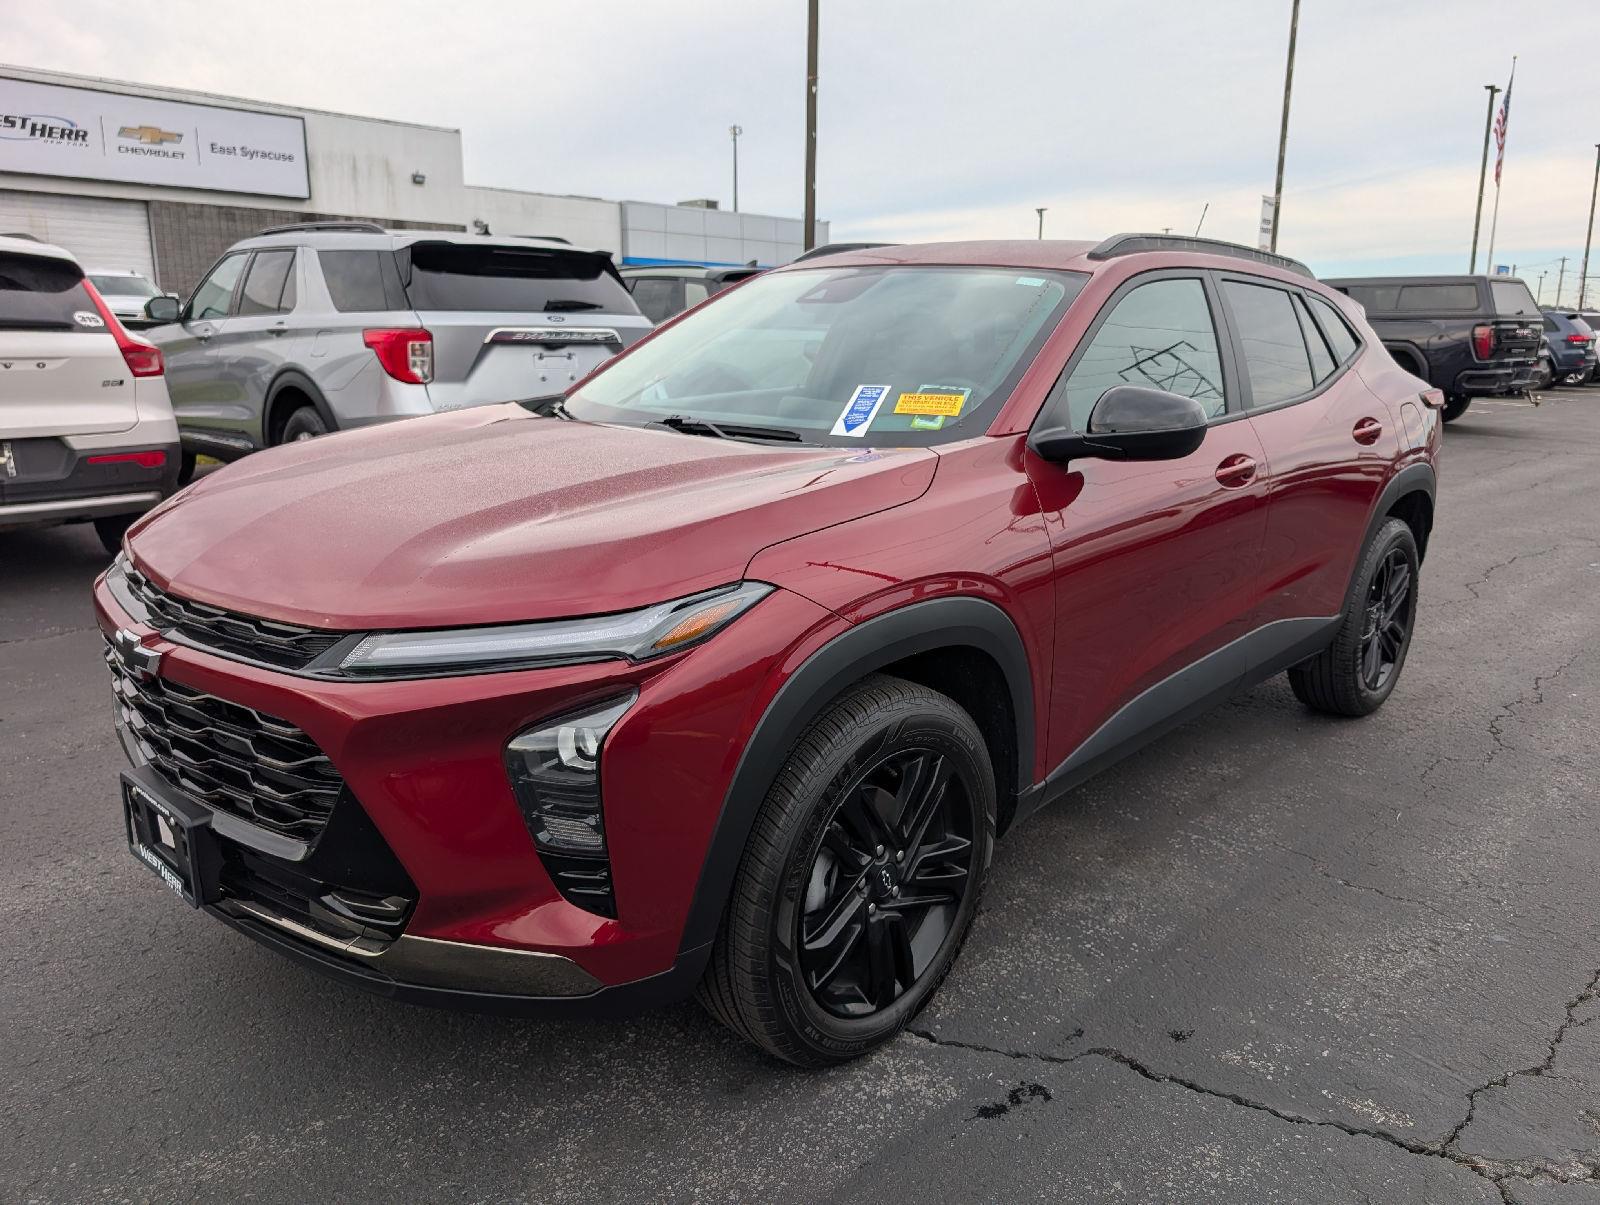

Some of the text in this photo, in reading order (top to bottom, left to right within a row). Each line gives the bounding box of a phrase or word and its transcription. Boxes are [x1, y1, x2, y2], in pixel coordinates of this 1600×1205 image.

[29, 121, 89, 142] HERR
[118, 145, 185, 161] CHEVROLET
[210, 142, 295, 163] East Syracuse
[140, 843, 162, 870] WEST
[161, 864, 182, 893] HERR
